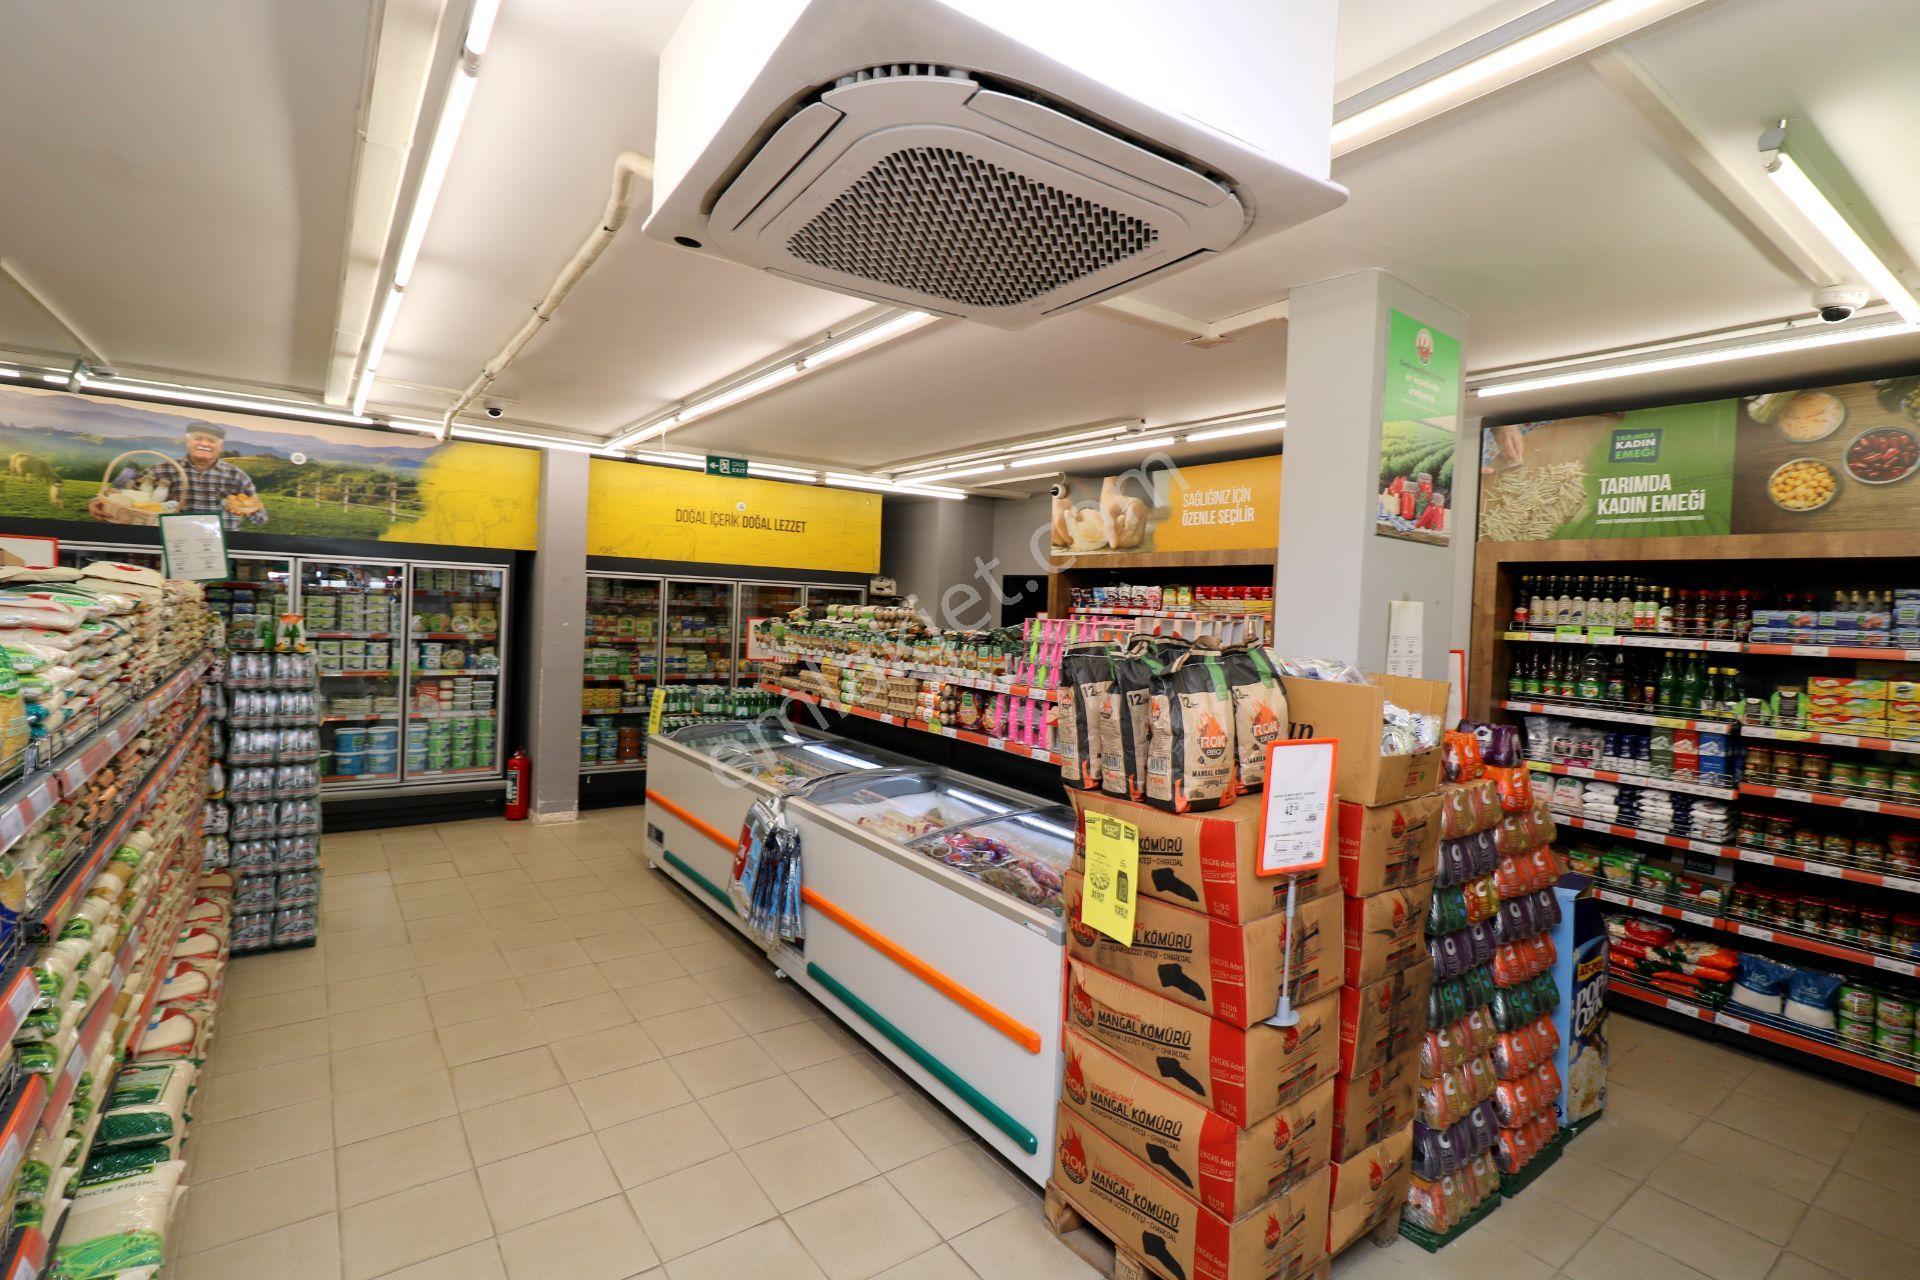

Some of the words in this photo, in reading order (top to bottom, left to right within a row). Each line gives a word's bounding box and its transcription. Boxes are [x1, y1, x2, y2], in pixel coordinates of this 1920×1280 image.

[1615, 438, 1656, 449] KADIN
[1615, 447, 1656, 459] EMEĞİ
[1599, 474, 1672, 495] TARIMDA
[1183, 488, 1232, 507] SAĞLIĞINIZ
[1232, 486, 1251, 505] İÇİN
[1598, 496, 1648, 515] KADIN
[1651, 489, 1706, 513] EMEĞİ
[676, 508, 708, 525] DOĞAL
[710, 510, 740, 528] İÇERİK
[742, 514, 772, 530] DOĞAL
[774, 519, 807, 533] LEZZET
[1182, 509, 1216, 526] ÖZENLE
[1218, 505, 1255, 526] SEÇİLİR
[1129, 694, 1143, 706] 12
[1253, 721, 1279, 736] ROK
[1200, 736, 1226, 748] ROK
[1138, 837, 1183, 852] KÖMÜRÜ
[1144, 929, 1192, 948] KÖMÜRÜ
[1097, 1010, 1138, 1033] MANGAL
[1140, 1022, 1191, 1047] KÖMÜRÜ
[1231, 1062, 1244, 1072] Adet
[1090, 1090, 1129, 1117] MANGAL
[1131, 1107, 1183, 1137] KÖMÜRÜ
[1061, 1148, 1088, 1178] ROK
[1200, 1150, 1219, 1163] 2KGX6
[1220, 1158, 1234, 1168] Adet
[1091, 1170, 1130, 1200] MANGAL
[1133, 1194, 1180, 1228] KÖMÜRÜ
